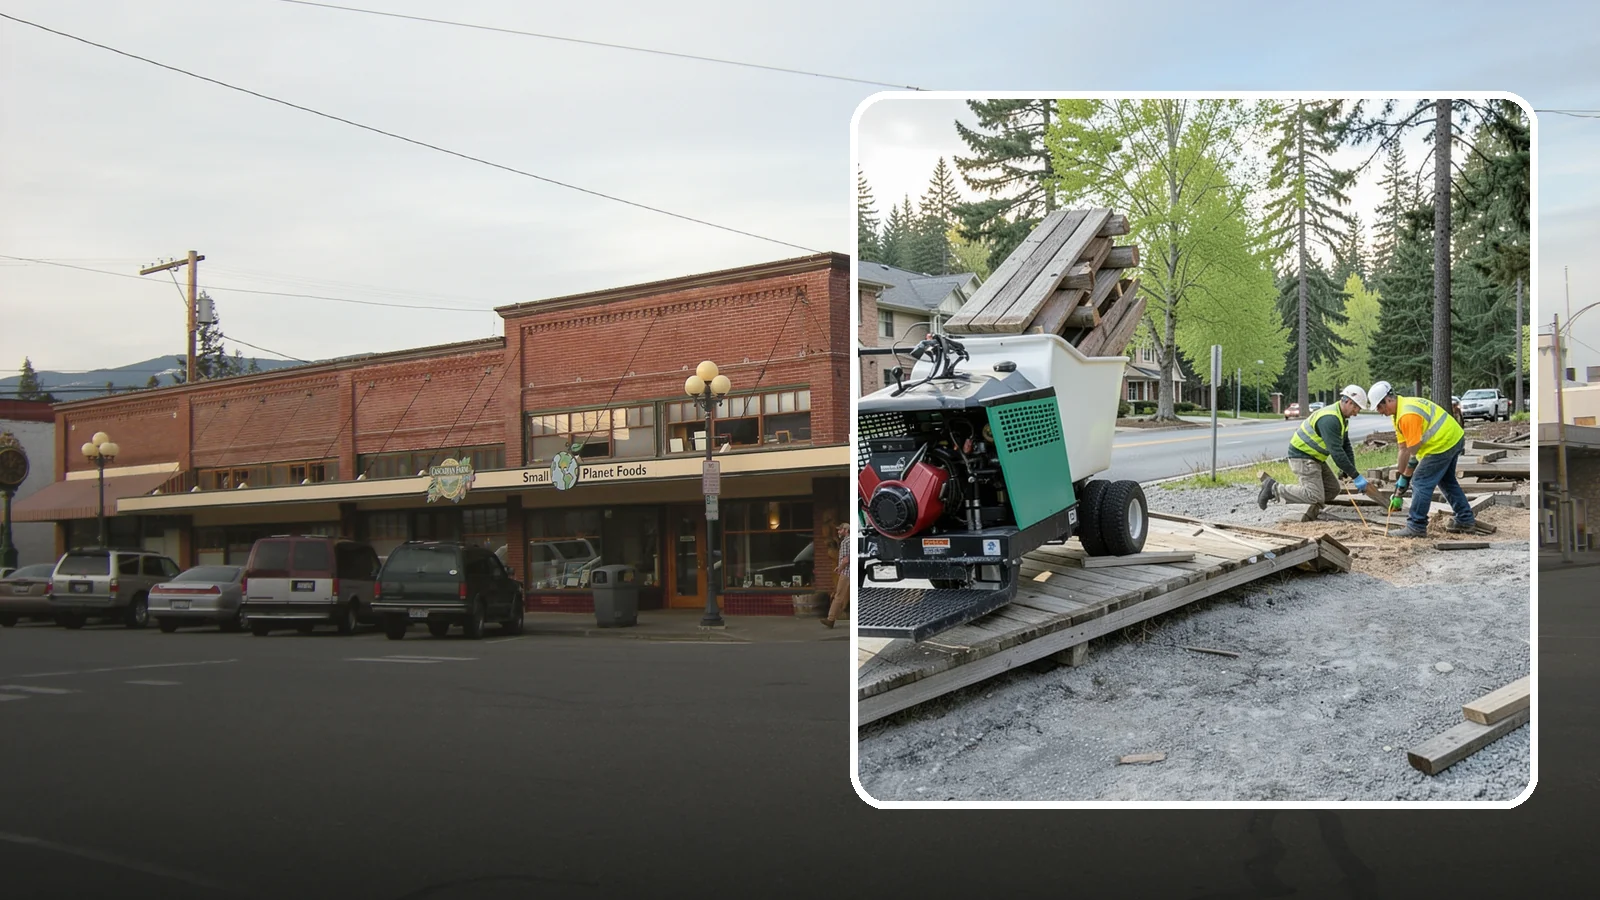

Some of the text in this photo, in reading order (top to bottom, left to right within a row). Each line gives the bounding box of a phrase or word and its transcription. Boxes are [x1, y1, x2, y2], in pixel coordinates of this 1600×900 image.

[432, 466, 469, 475] CASCADIAN FARM
[523, 464, 647, 482] Small Planet Foods
